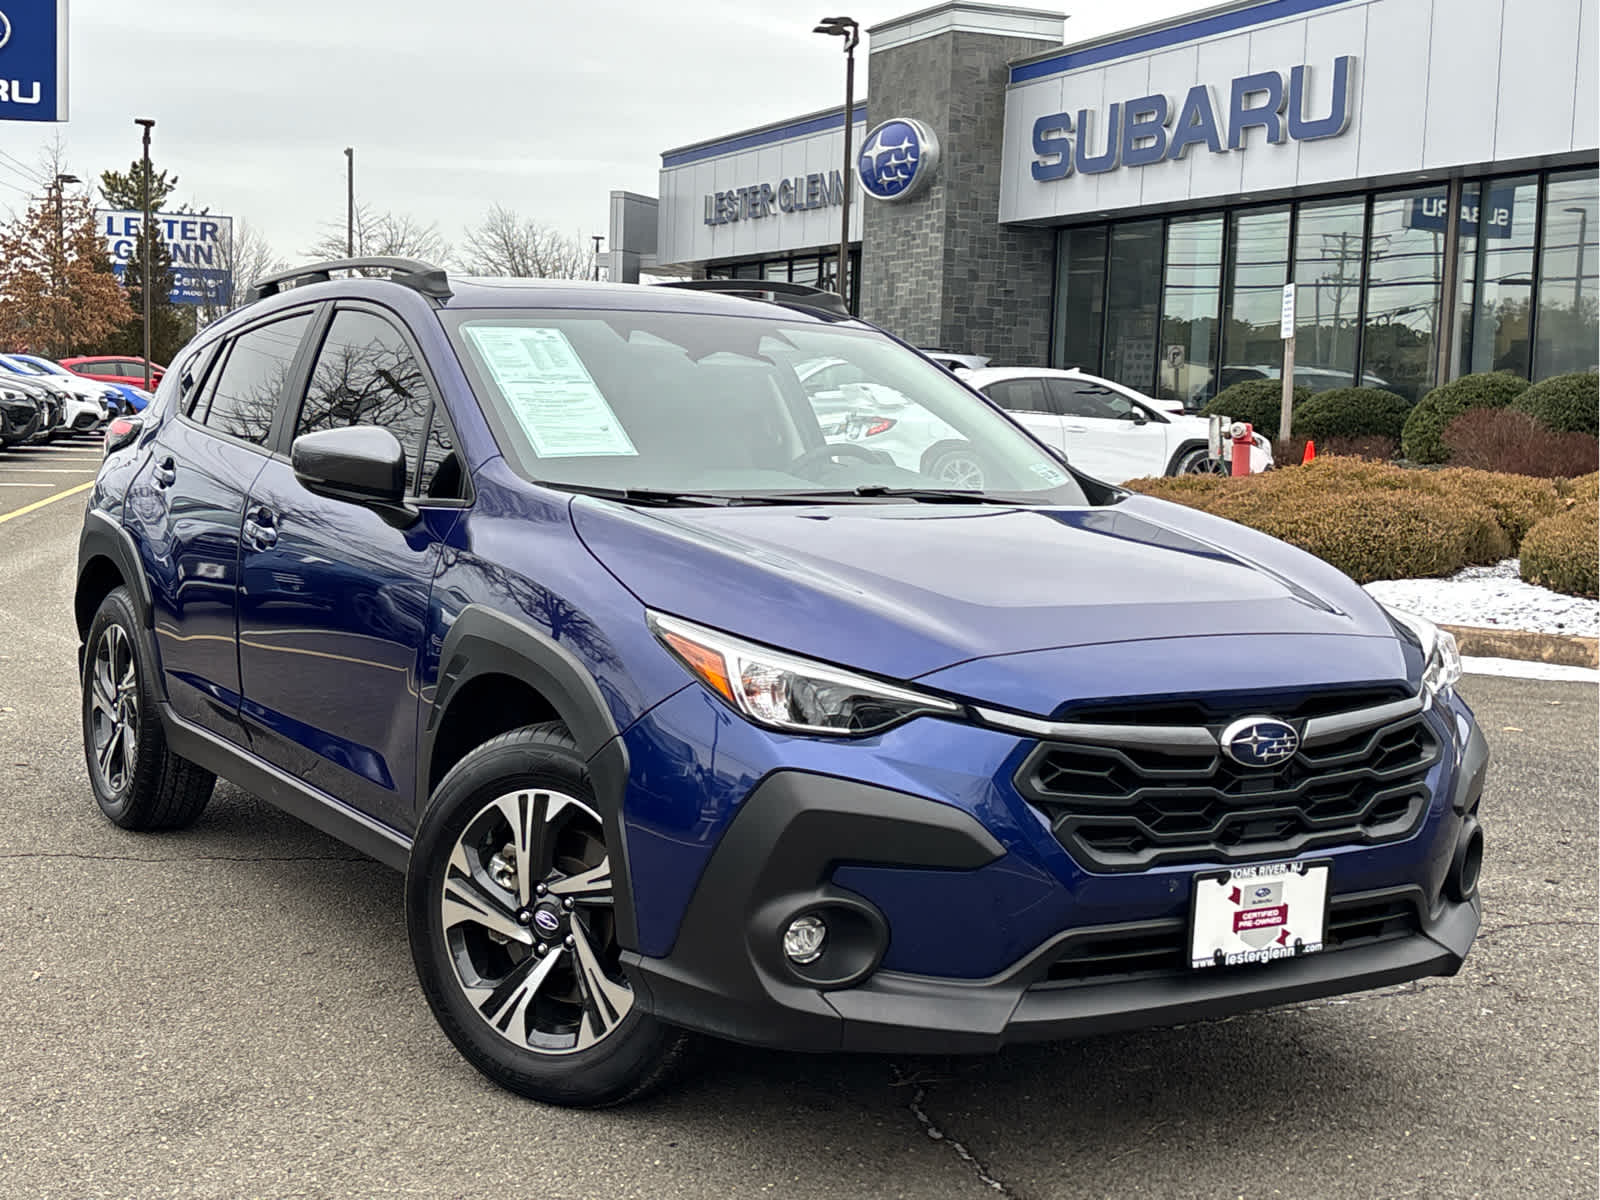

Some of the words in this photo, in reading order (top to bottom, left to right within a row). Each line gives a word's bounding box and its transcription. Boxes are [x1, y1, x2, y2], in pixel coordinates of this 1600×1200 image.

[1031, 55, 1356, 183] SUBARU
[704, 183, 776, 226] LESTER
[778, 168, 854, 213] GLENN
[106, 216, 218, 241] LETER
[113, 240, 213, 264] GNN
[1230, 867, 1257, 879] TOMS
[1291, 862, 1303, 874] NJ
[1238, 916, 1282, 928] PRE-OWNED
[1242, 909, 1279, 920] CERTIFIED
[1225, 945, 1295, 965] lesterglenn
